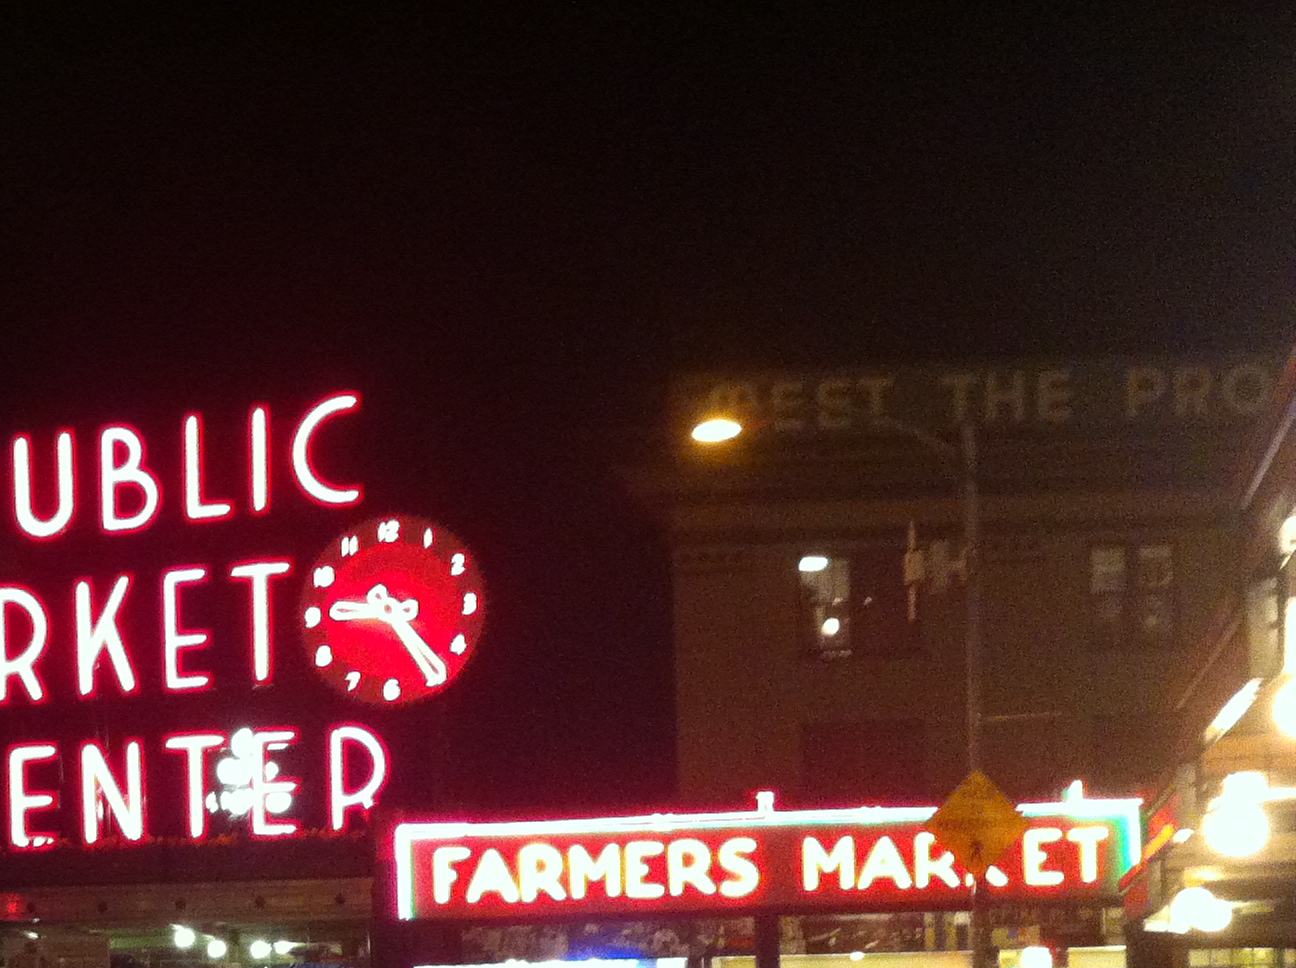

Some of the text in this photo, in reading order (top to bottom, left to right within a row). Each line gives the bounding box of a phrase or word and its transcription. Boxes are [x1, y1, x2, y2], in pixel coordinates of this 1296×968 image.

[938, 367, 1072, 425] THE
[1125, 362, 1271, 418] PRO
[378, 519, 400, 543] 12
[341, 535, 359, 557] 11
[451, 553, 466, 576] 2
[432, 838, 759, 905] FARMERS
